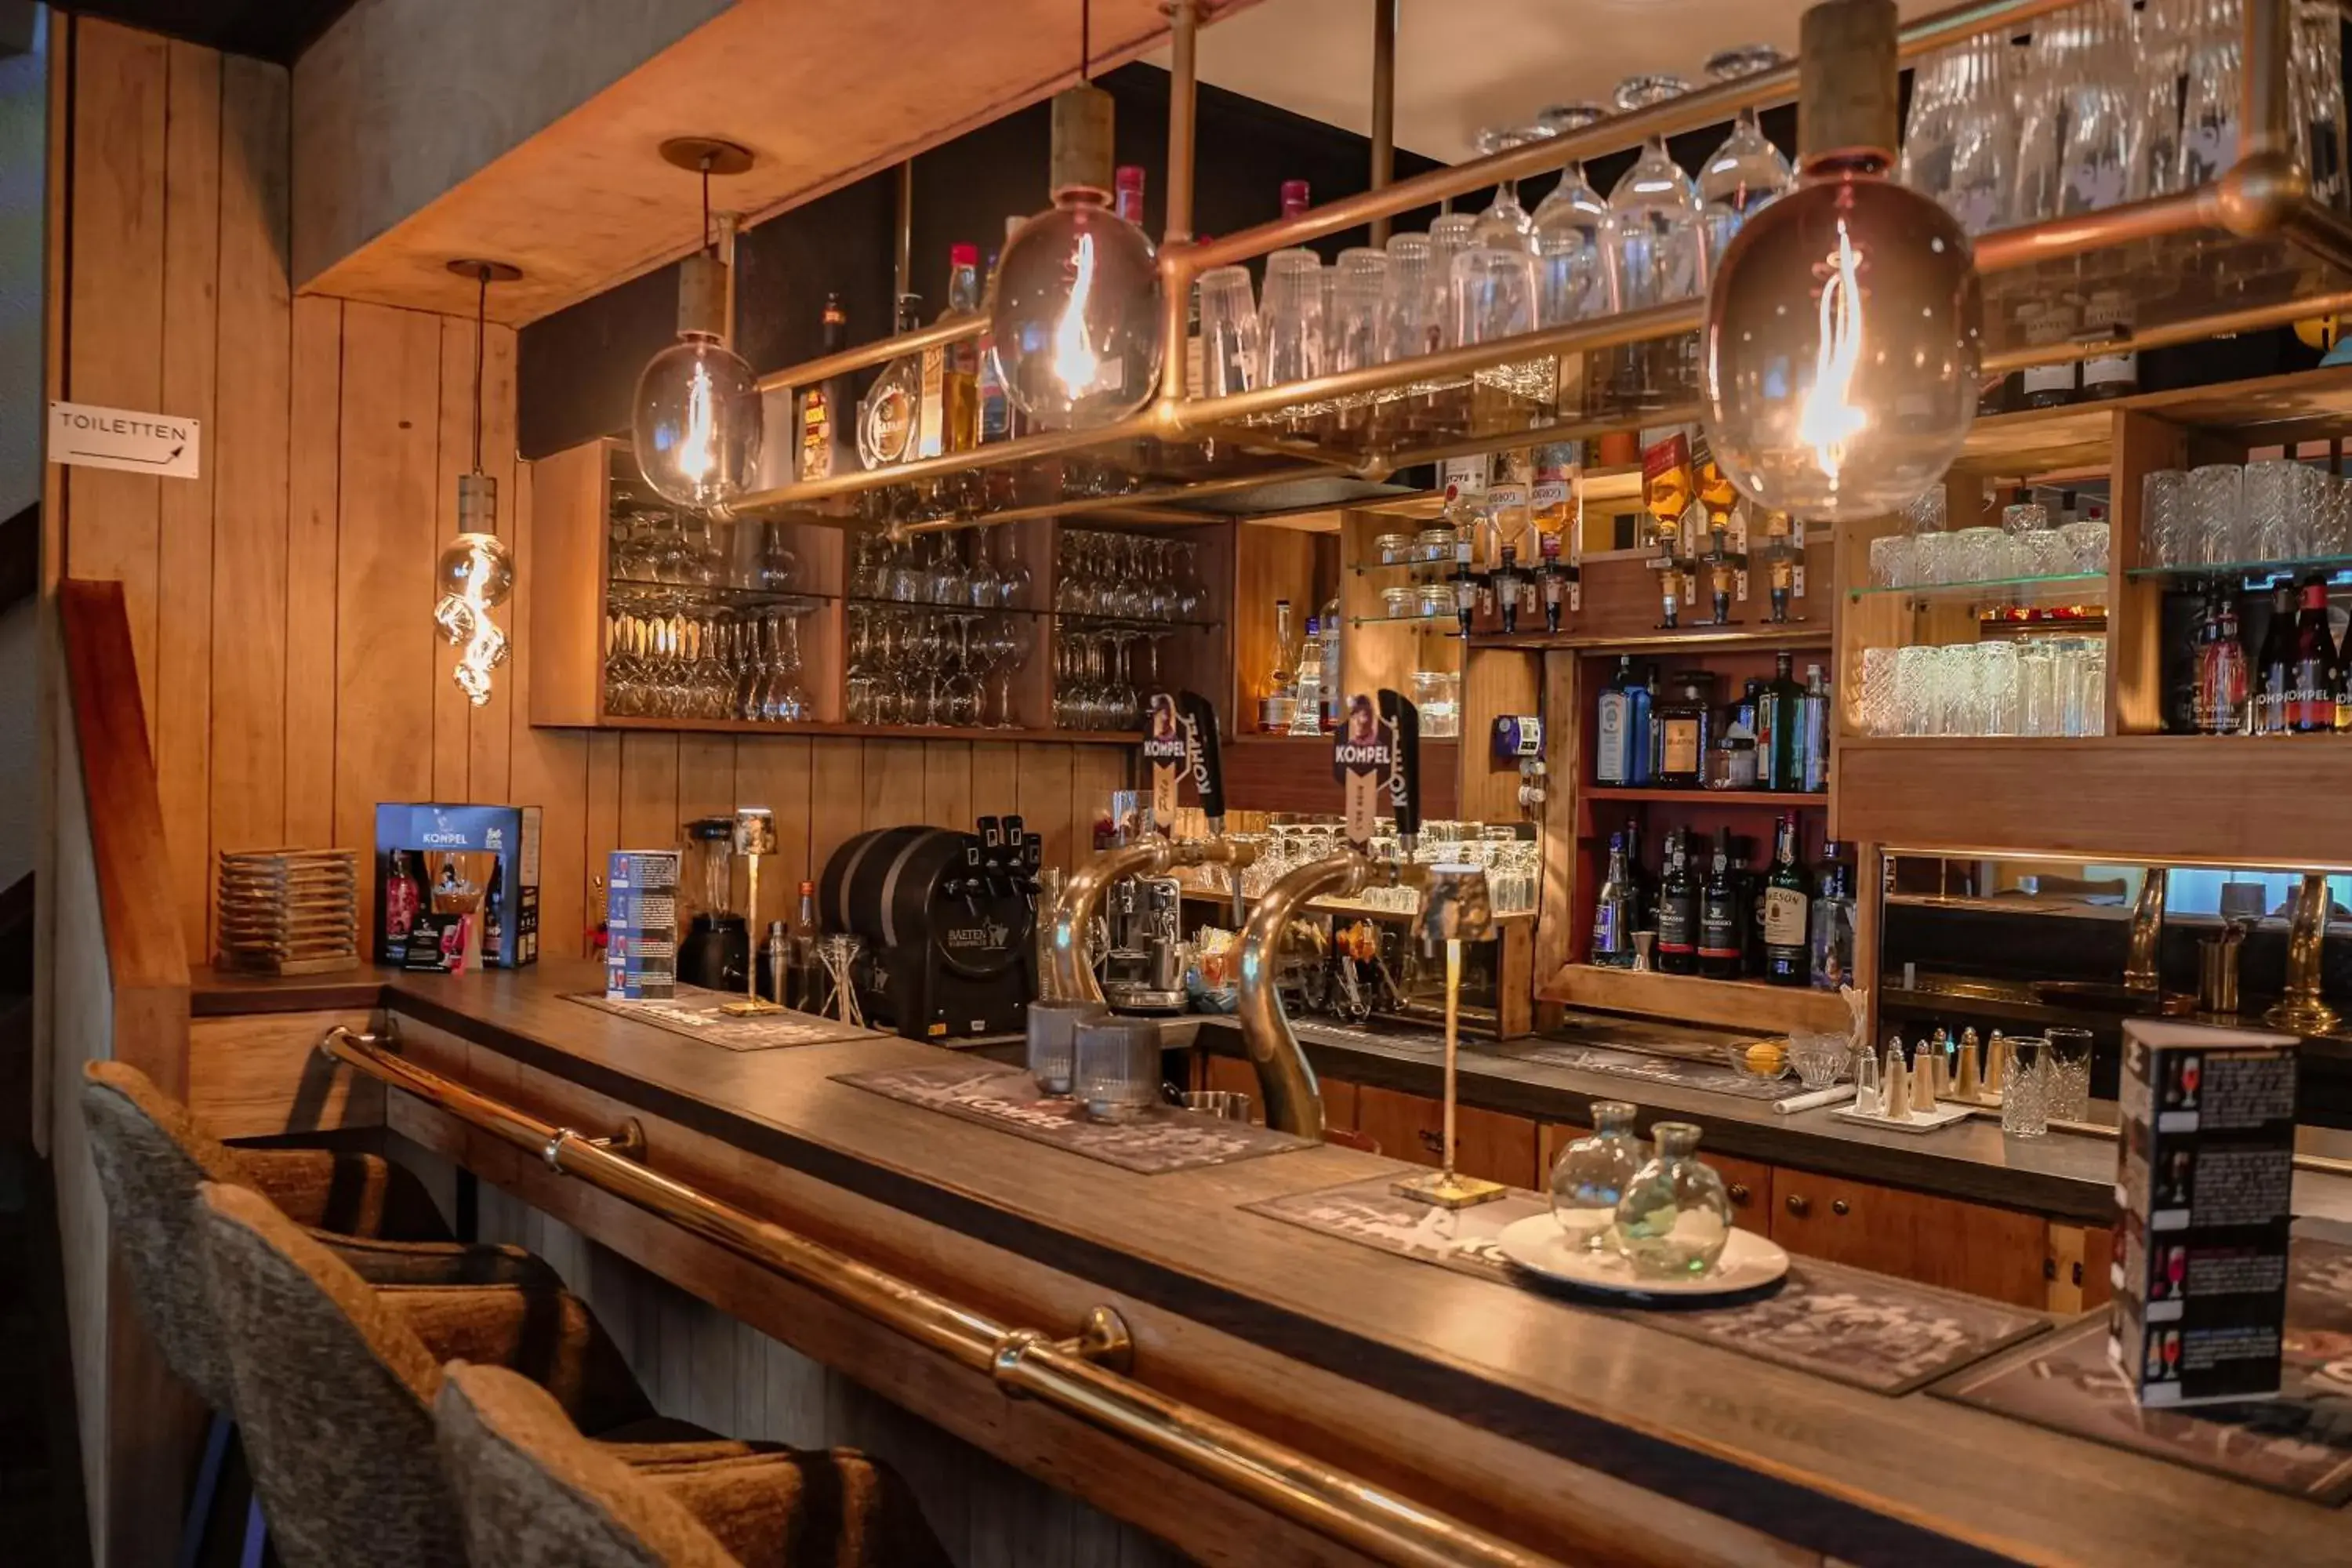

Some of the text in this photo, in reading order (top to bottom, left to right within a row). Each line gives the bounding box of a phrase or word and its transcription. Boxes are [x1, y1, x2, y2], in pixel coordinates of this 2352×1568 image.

[60, 412, 187, 441] TOILETTEN
[1144, 740, 1185, 757] KOMPEL
[1335, 746, 1391, 764] KOMPEL
[423, 833, 469, 844] KOMPEL
